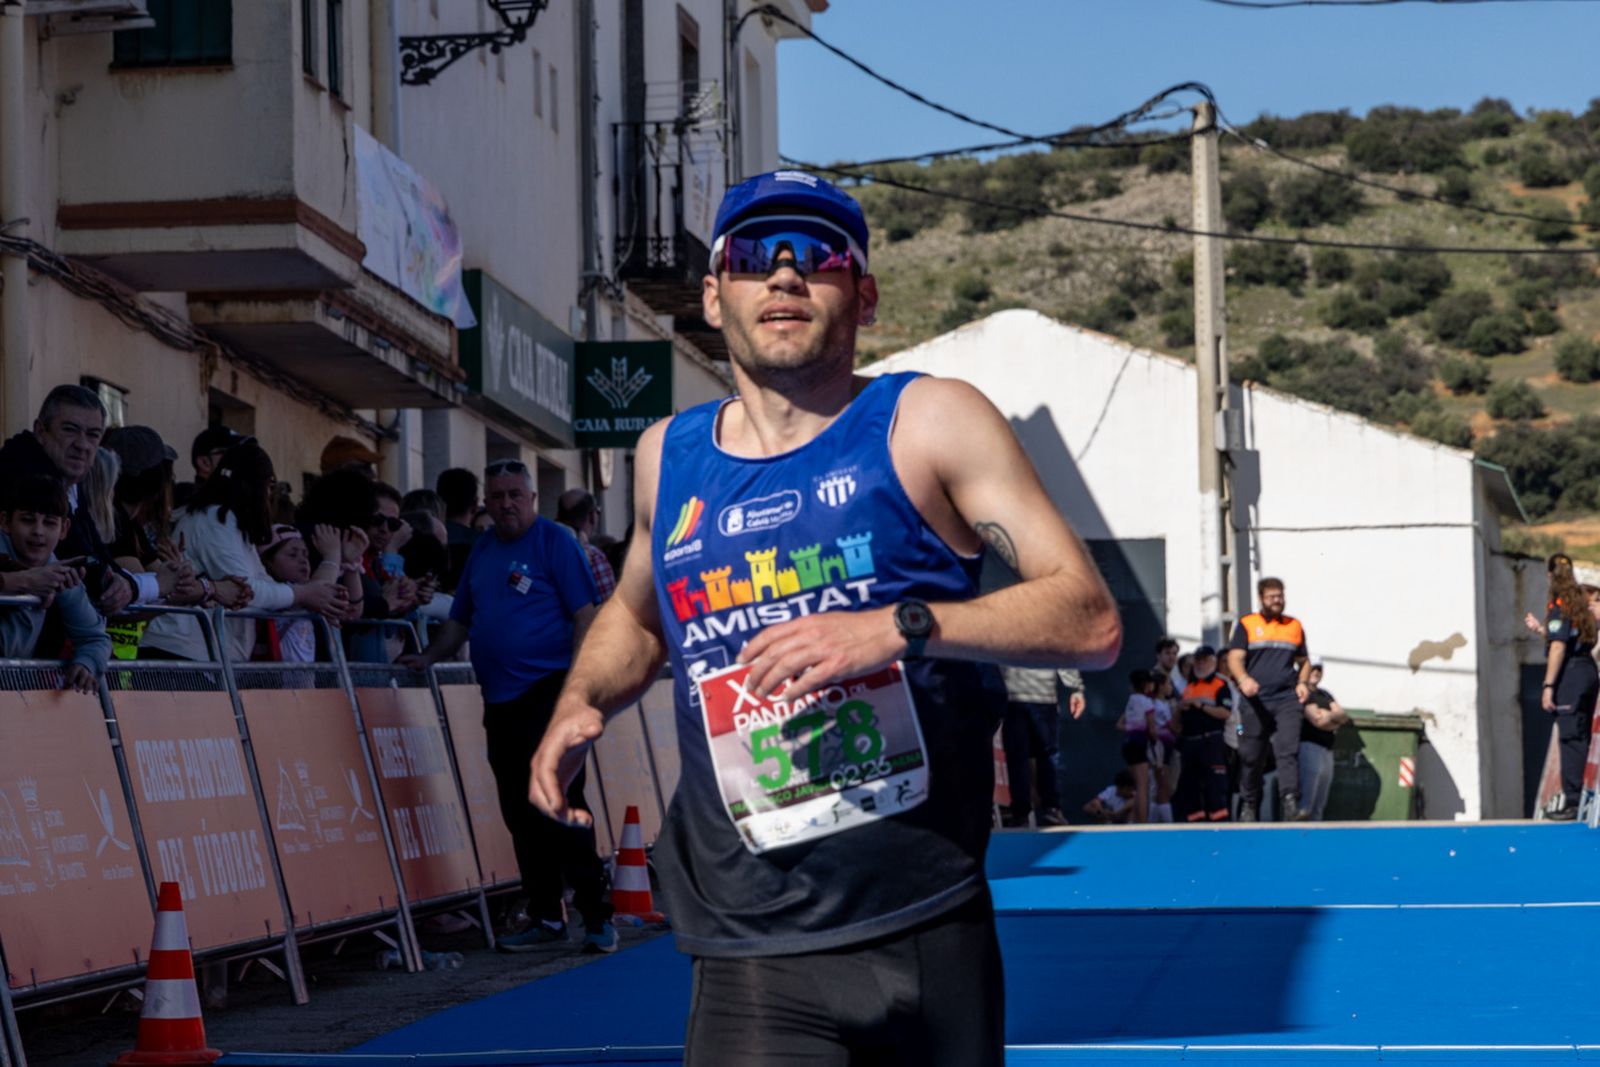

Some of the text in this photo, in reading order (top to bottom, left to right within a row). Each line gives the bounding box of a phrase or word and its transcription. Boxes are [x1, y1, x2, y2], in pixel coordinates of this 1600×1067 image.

[682, 577, 877, 648] AMISTAT
[135, 739, 186, 803] CROSS
[749, 699, 883, 790] 578
[157, 837, 197, 901] DEL
